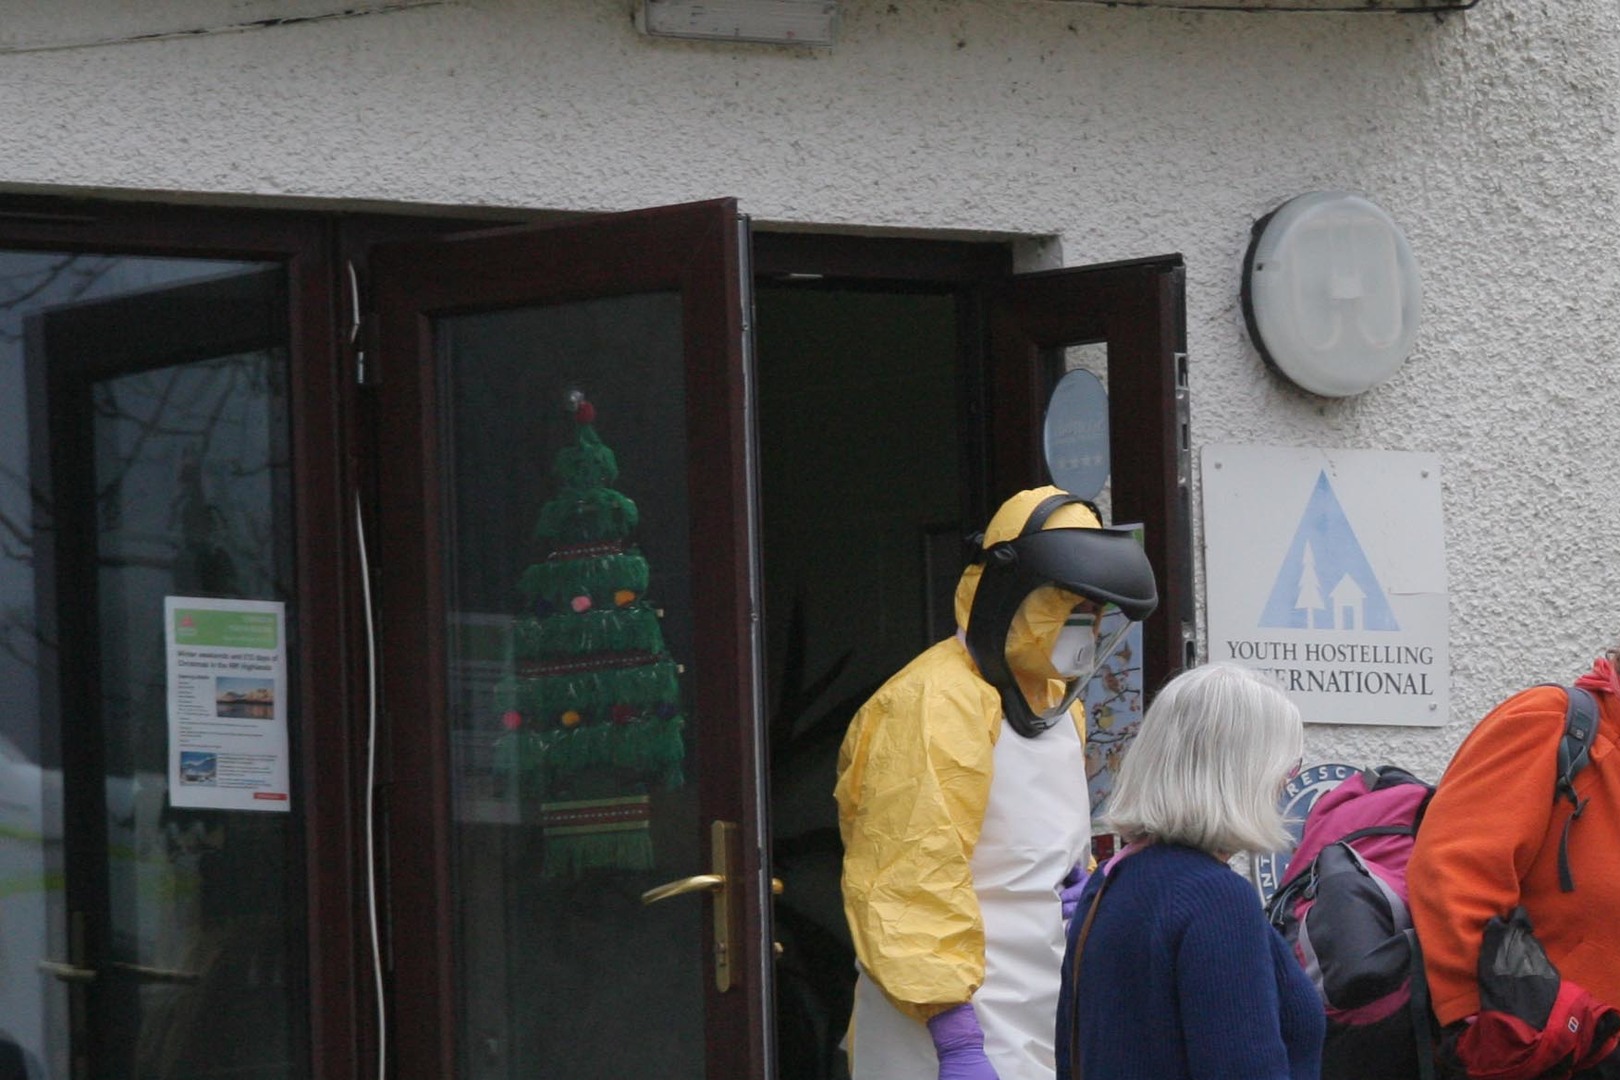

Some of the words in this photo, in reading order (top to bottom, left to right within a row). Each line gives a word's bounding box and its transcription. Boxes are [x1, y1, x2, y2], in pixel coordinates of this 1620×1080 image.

[1227, 641, 1297, 661] YOUTH
[1305, 643, 1434, 665] HOSTELLING
[1252, 667, 1434, 696] ERNATIONAL
[1286, 766, 1361, 798] RESC
